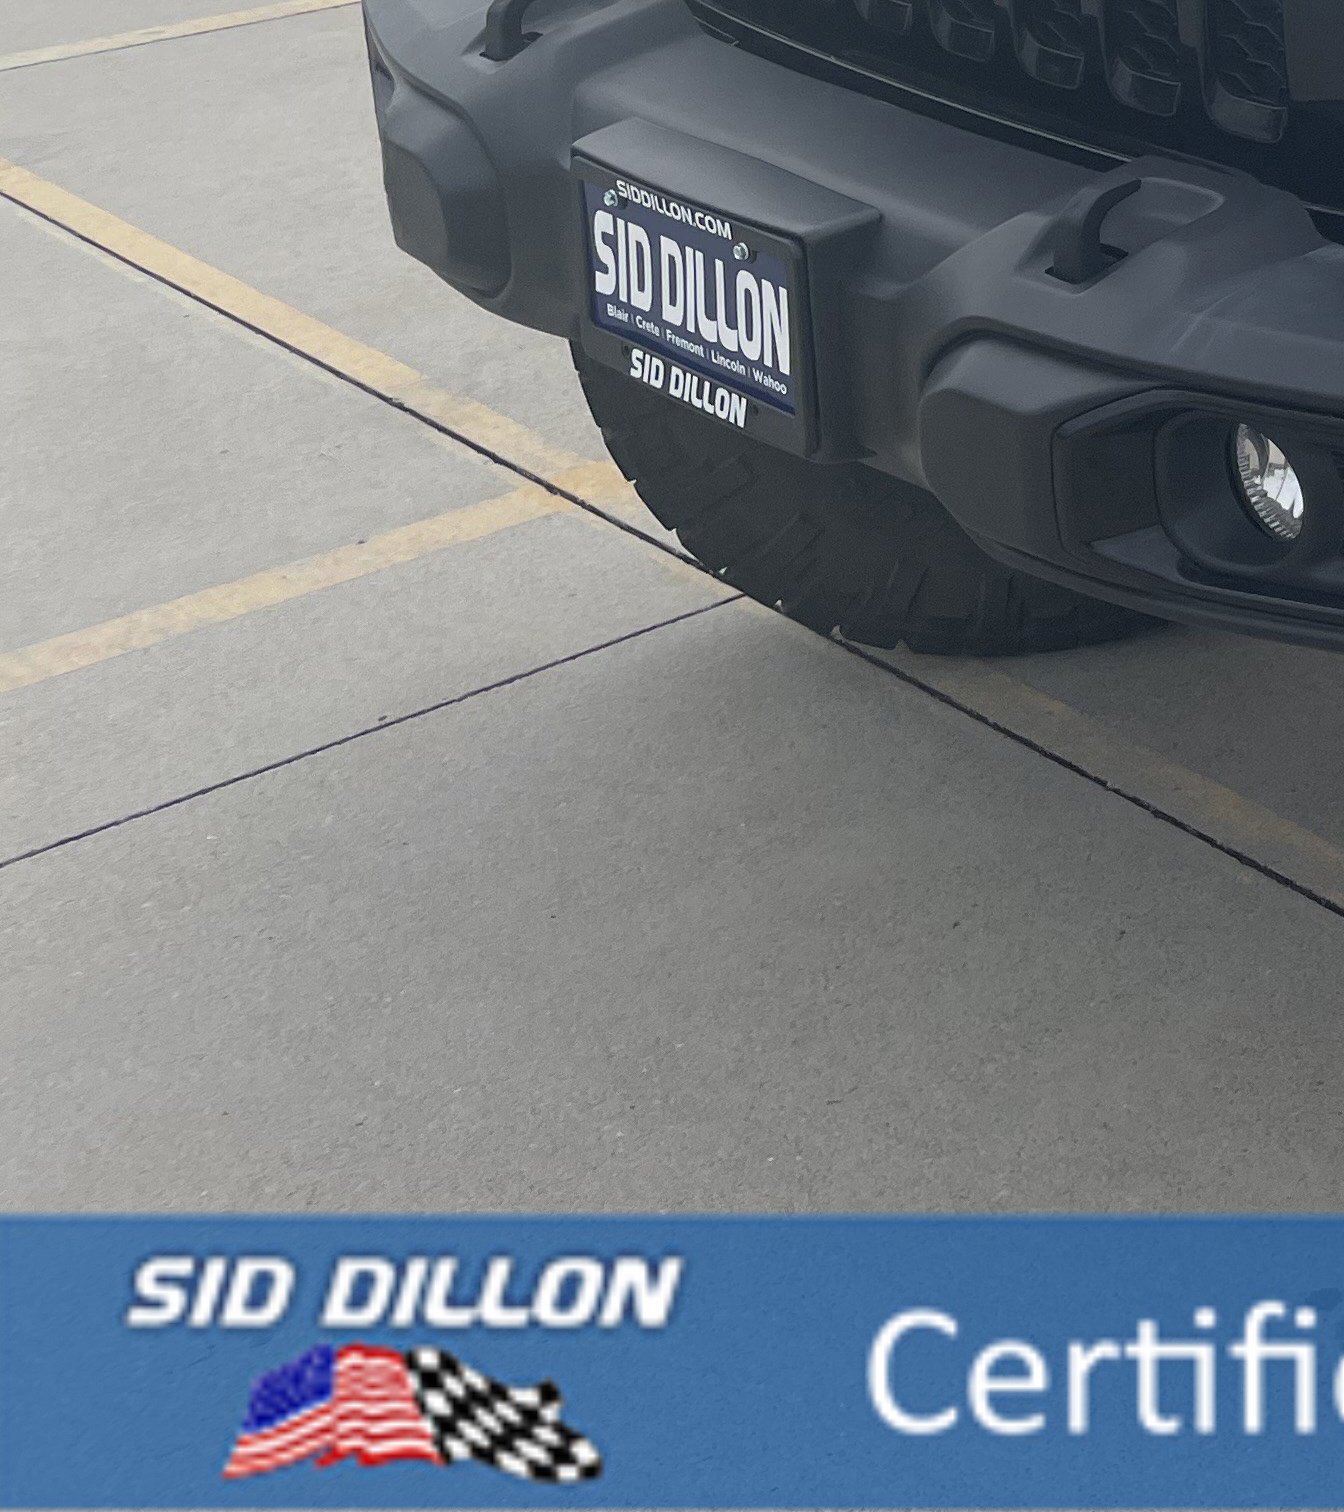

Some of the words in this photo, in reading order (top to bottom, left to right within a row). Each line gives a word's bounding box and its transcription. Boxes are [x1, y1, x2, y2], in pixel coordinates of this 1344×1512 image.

[616, 180, 732, 239] SIDDILLON.COM
[594, 210, 652, 312] SID
[659, 235, 790, 375] DILLON
[607, 304, 629, 323] Blair
[635, 315, 660, 337] Crete
[666, 329, 704, 358] Fremont
[711, 350, 746, 374] Lincoln
[753, 367, 787, 395] Wahoo
[630, 348, 664, 389] SID
[668, 365, 747, 428] DILLON
